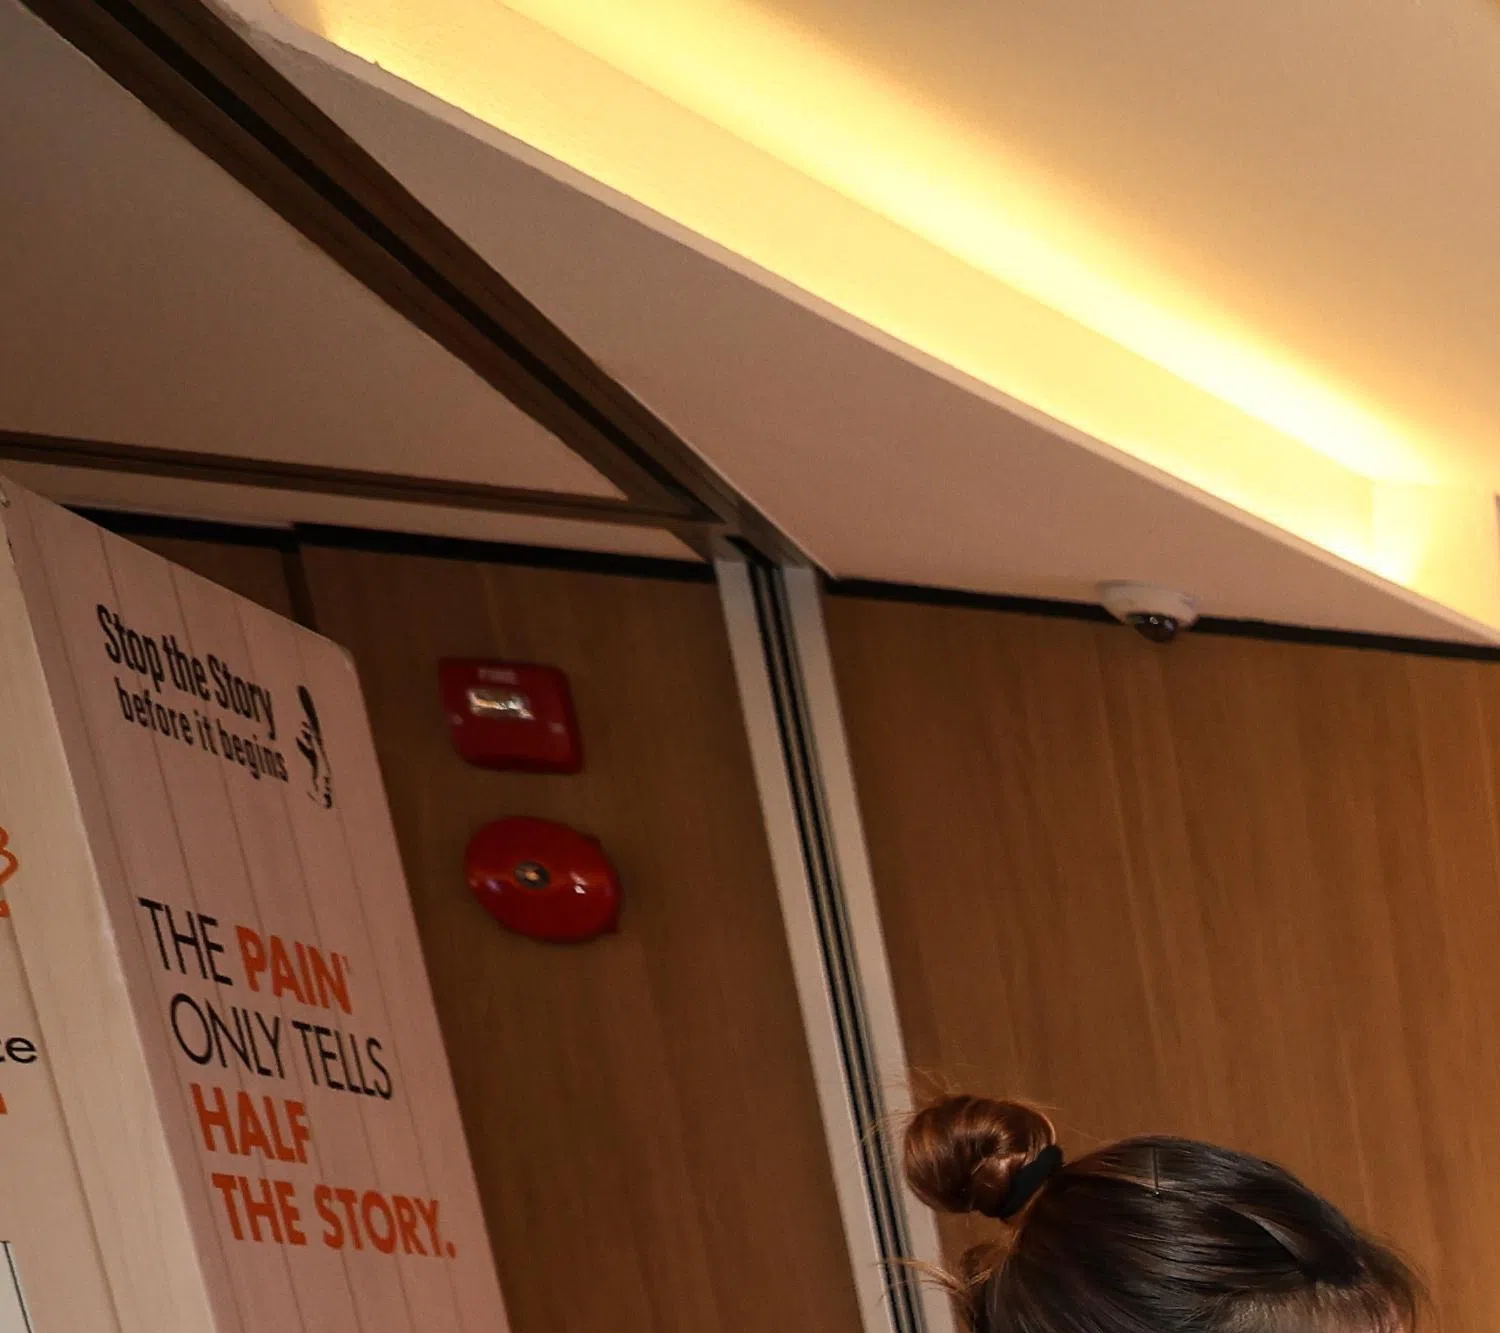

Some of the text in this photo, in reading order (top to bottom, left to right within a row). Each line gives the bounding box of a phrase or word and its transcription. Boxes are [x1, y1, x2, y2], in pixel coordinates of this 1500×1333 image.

[96, 604, 276, 740] Stop the Story
[114, 676, 289, 783] before it begins
[138, 897, 352, 1015] THE PAIN
[170, 993, 392, 1100] ONLY TELLS
[190, 1082, 312, 1164] HALF
[211, 1172, 456, 1259] THE STORY.
